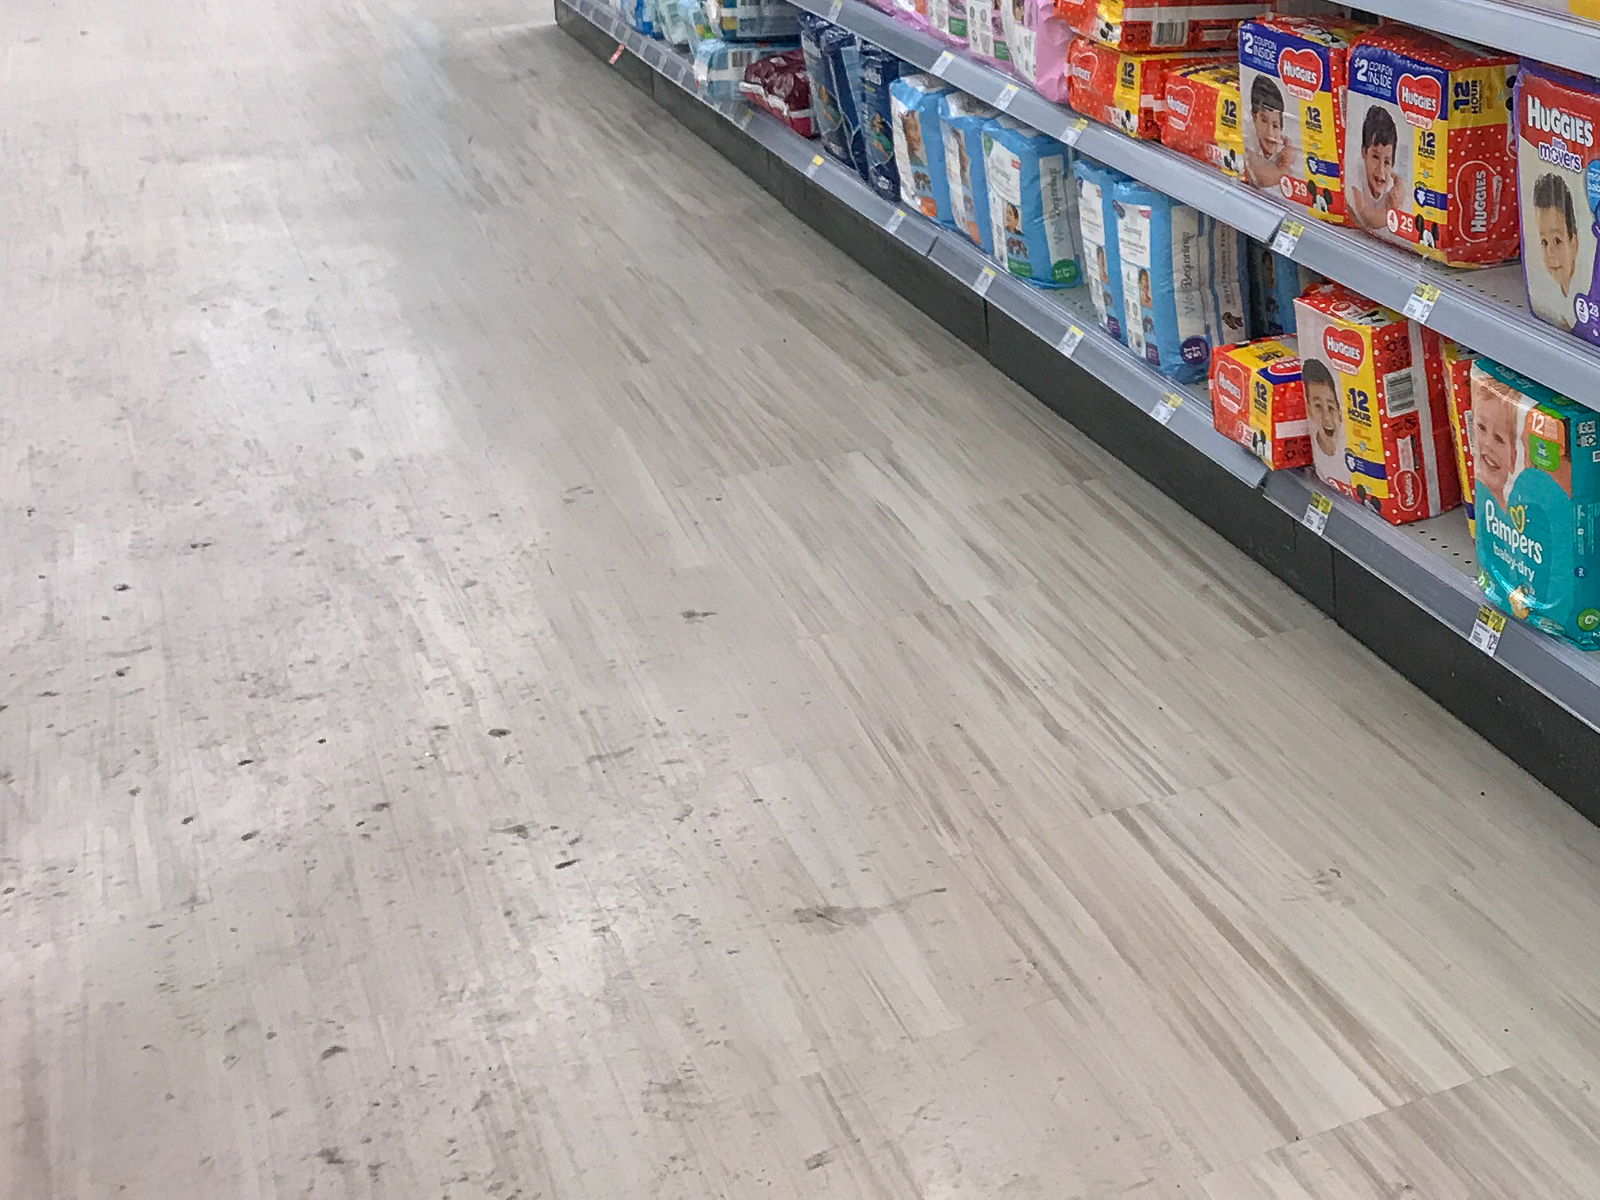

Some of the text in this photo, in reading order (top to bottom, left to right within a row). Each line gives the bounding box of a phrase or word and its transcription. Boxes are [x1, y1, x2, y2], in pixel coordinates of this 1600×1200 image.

[1283, 59, 1317, 86] HUGGIES
[1401, 86, 1436, 112] HUGGIES
[1527, 95, 1594, 148] HUGGIES
[1539, 144, 1582, 173] movers
[1471, 170, 1486, 233] HUGGIES
[1327, 338, 1361, 361] HUGGIES
[1348, 388, 1369, 412] 12
[1485, 499, 1543, 564] Pampers
